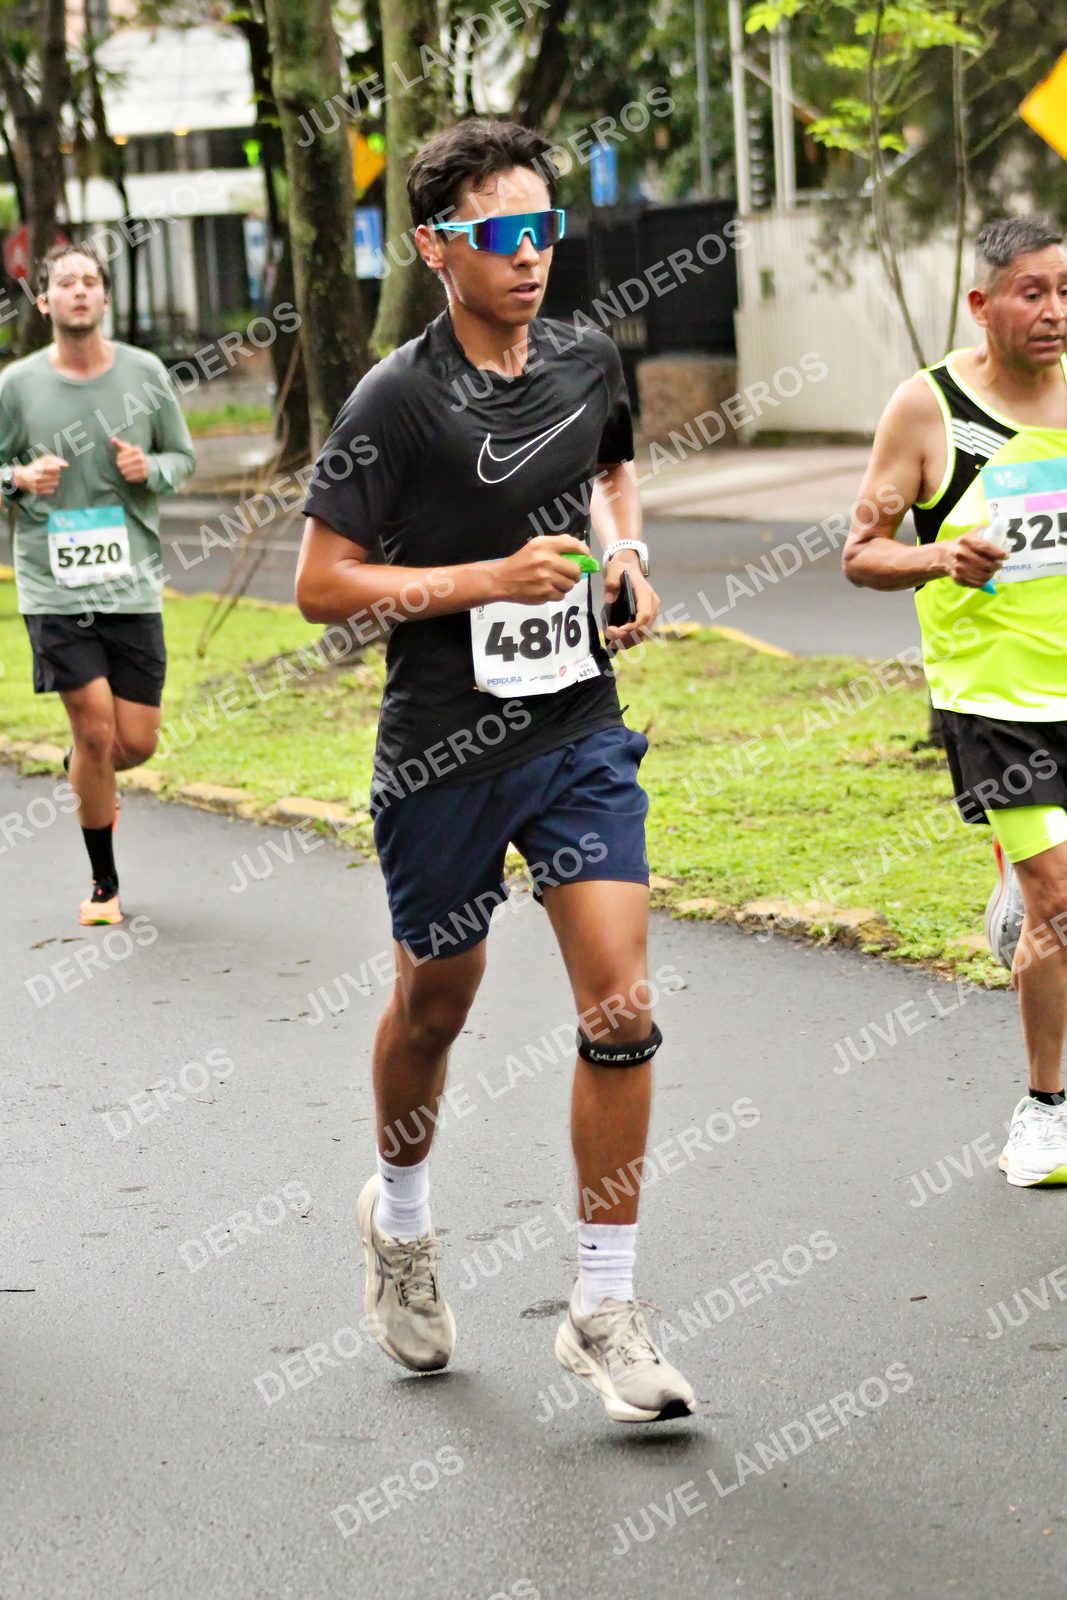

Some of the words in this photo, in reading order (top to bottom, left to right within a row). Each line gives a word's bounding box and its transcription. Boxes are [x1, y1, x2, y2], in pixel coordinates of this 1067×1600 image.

[57, 542, 122, 568] 5220
[485, 605, 582, 662] 4876
[487, 676, 523, 686] PERDURA
[596, 1044, 658, 1062] MUELLER
